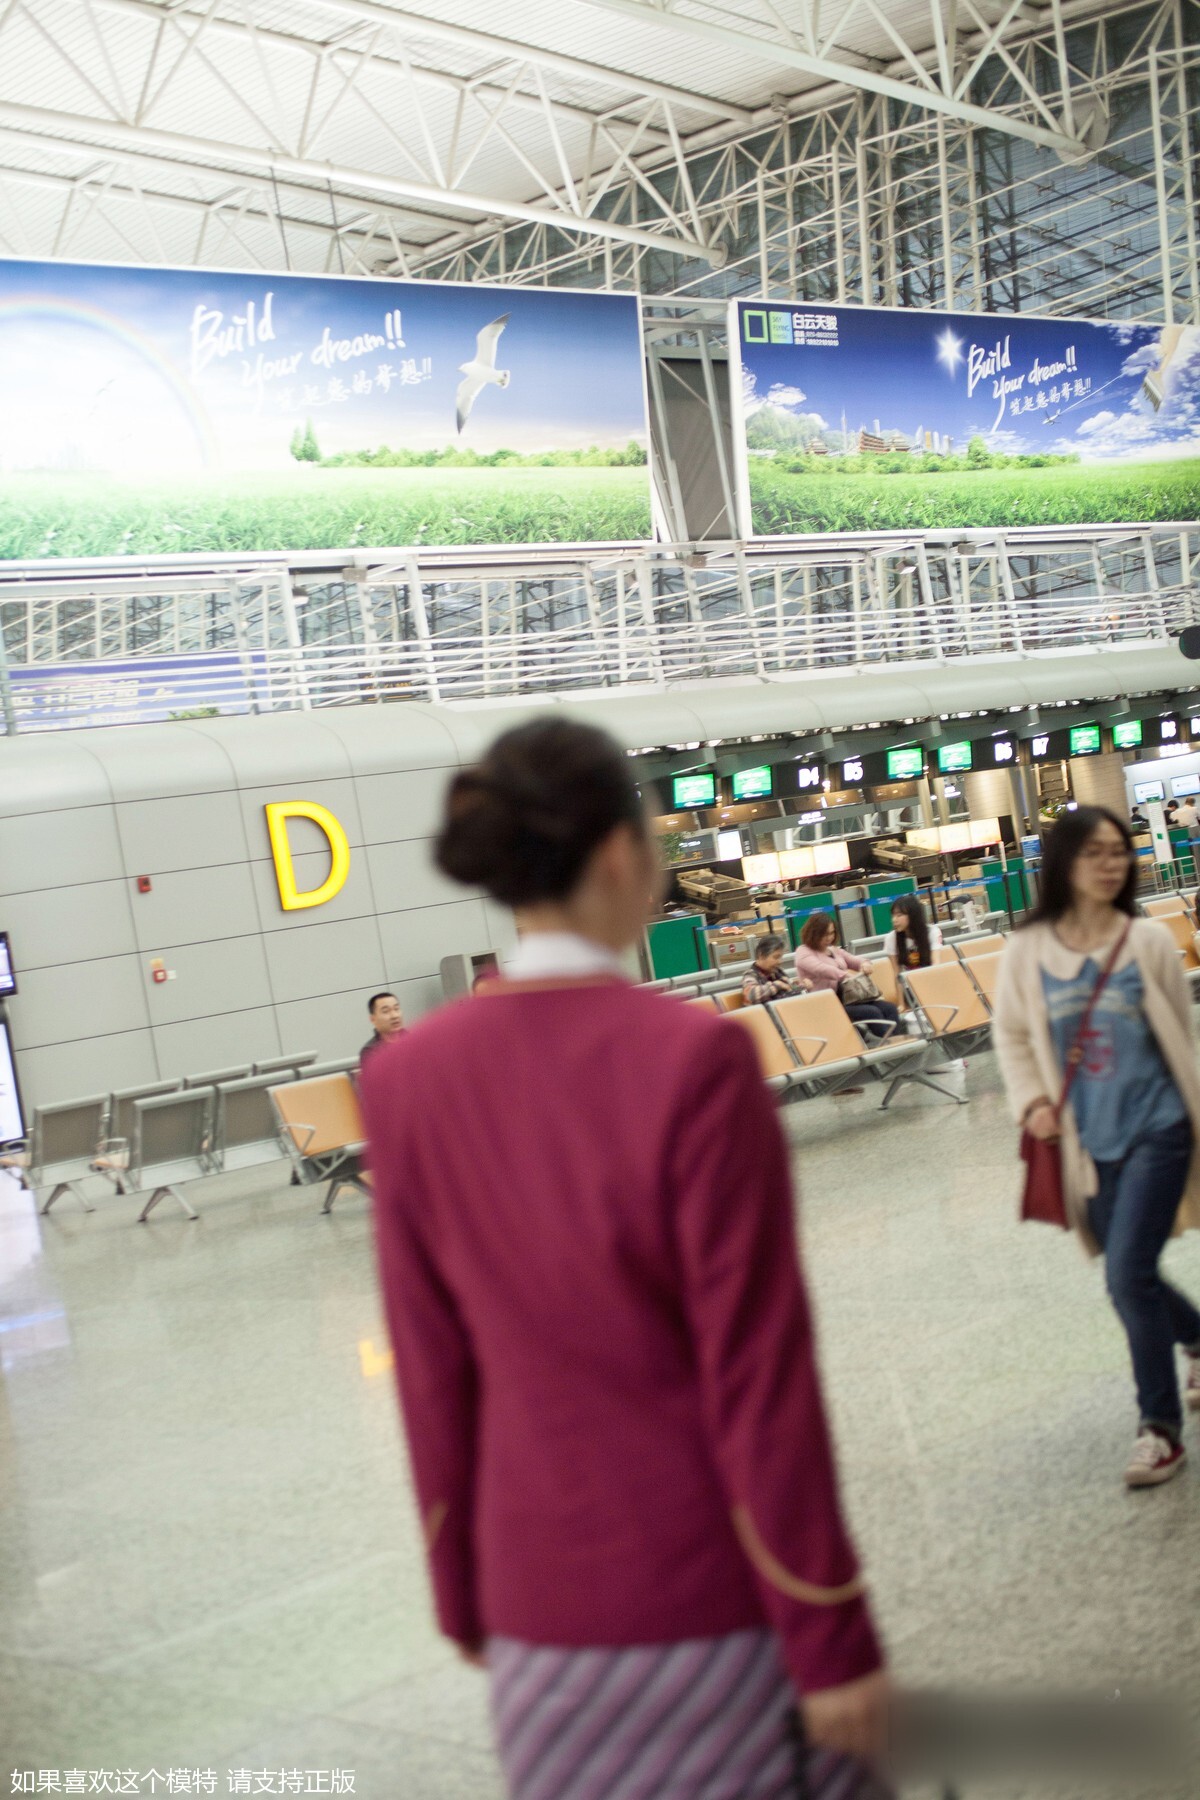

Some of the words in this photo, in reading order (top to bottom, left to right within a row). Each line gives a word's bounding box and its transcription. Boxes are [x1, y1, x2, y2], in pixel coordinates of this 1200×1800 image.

[190, 292, 276, 382] Build
[311, 309, 406, 369] dream!!
[967, 335, 1011, 398] Build
[1028, 346, 1077, 386] dream!!
[798, 766, 819, 788] D4
[843, 761, 863, 782] D5
[265, 800, 350, 911] D
